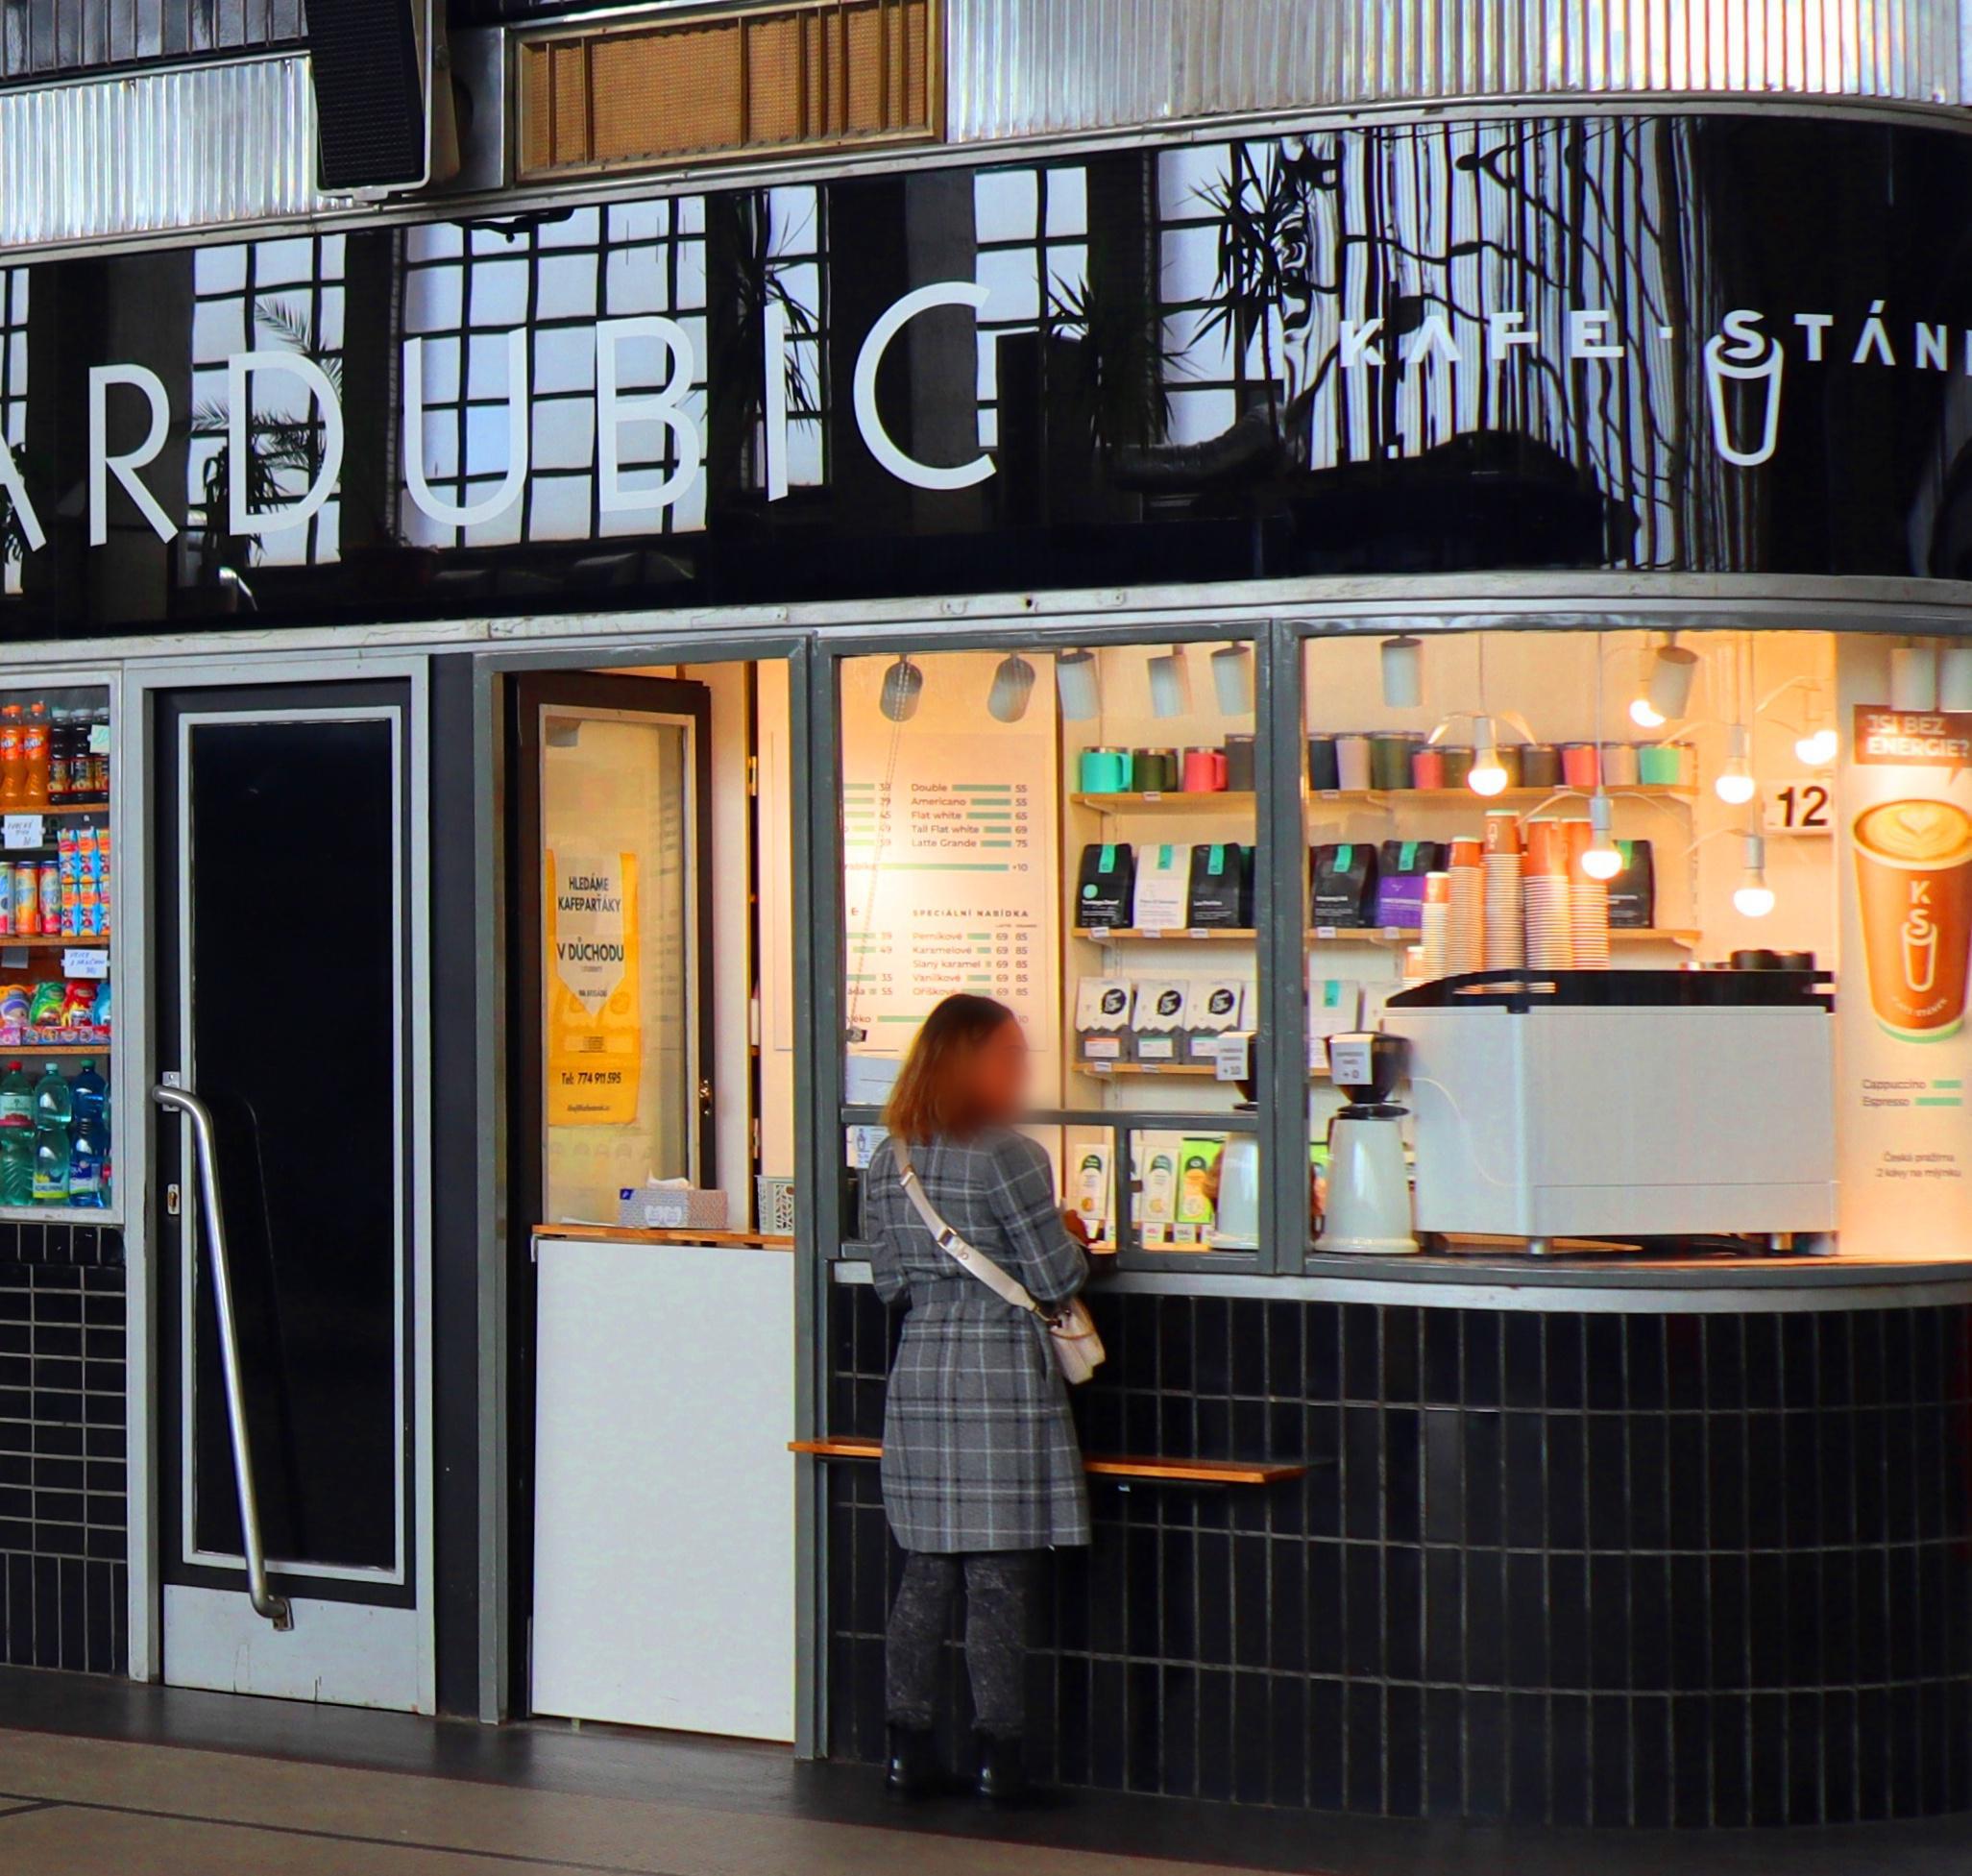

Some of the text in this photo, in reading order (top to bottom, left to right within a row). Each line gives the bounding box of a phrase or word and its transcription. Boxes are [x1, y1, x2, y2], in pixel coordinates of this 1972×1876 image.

[1722, 299, 1972, 376] STÁN
[1904, 716, 1947, 735] BEZ
[1866, 737, 1969, 757] ENERGIE?
[911, 783, 1028, 793] Double 55
[911, 796, 1028, 807] Americano 55
[1777, 786, 1829, 827] 12
[911, 811, 1028, 820] Flat white 65
[912, 825, 1028, 835] Tall Flat white 69
[912, 839, 1029, 848] Latte Grande 75
[569, 873, 610, 891] HLEDÁME
[1910, 880, 1932, 905] K
[558, 893, 621, 912] KAFEPARŤÁKY
[913, 908, 1029, 917] SPECIÁLNÍ NABÍDKA
[995, 932, 1009, 941] 69
[1015, 932, 1028, 941] 85
[557, 936, 624, 962] V DŮCHODU
[995, 946, 1009, 955] 69
[1015, 946, 1028, 955] 85
[941, 960, 982, 968] karamel
[995, 961, 1009, 969] 69
[1015, 961, 1028, 969] 85
[995, 974, 1010, 983] 69
[1015, 974, 1029, 983] 85
[995, 987, 1010, 996] 69
[1015, 987, 1029, 996] 85
[577, 1072, 593, 1084] 774
[1862, 1079, 1927, 1090] Cappuccino
[1862, 1096, 1911, 1108] Espresso
